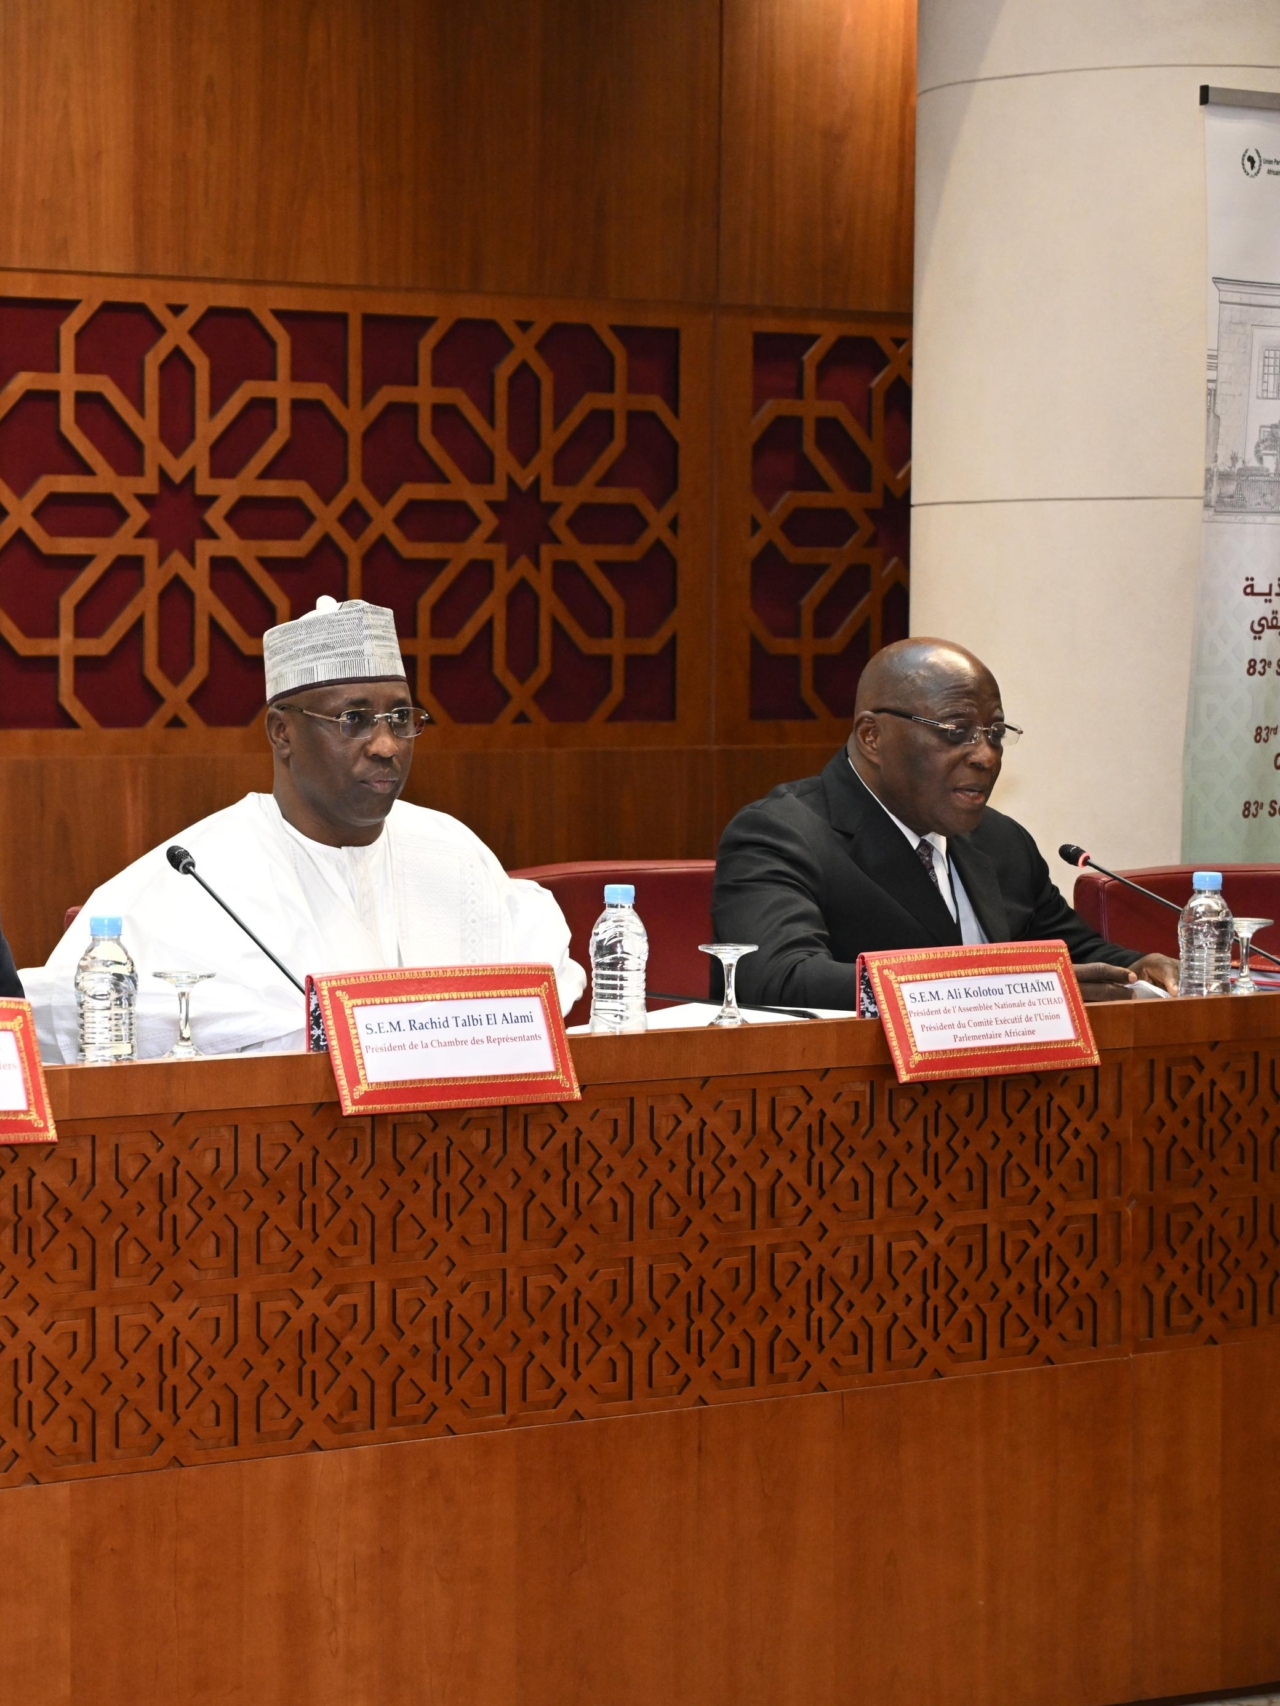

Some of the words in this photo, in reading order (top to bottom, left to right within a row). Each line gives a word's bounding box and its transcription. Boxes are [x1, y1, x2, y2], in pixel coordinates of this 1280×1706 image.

[1254, 725, 1278, 744] 83rd
[909, 990, 944, 1004] S.E.M.
[947, 987, 962, 1000] Ali
[963, 985, 1004, 999] Kolotou
[1005, 979, 1055, 995] TCHAÏMI
[908, 1007, 941, 1018] Président
[943, 1006, 951, 1015] de
[994, 999, 1026, 1010] Nationale
[1027, 999, 1036, 1007] du
[1037, 996, 1064, 1006] TCHAD
[365, 1020, 406, 1035] S.E.M.
[408, 1015, 450, 1032] Rachid
[452, 1014, 483, 1028] Talbi
[485, 1012, 498, 1026] El
[501, 1010, 534, 1025] Alami
[920, 1021, 955, 1032] Président
[957, 1020, 967, 1029] du
[967, 1018, 994, 1028] Comité
[994, 1014, 1023, 1026] Exécutif
[1024, 1013, 1033, 1023] de
[365, 1042, 407, 1054] Président
[408, 1040, 419, 1050] de
[420, 1039, 429, 1050] la
[430, 1037, 468, 1049] Chambre
[470, 1036, 485, 1046] des
[486, 1033, 542, 1046] Représentants
[953, 1030, 1002, 1043] Parlementaire
[1004, 1027, 1036, 1038] Africaine
